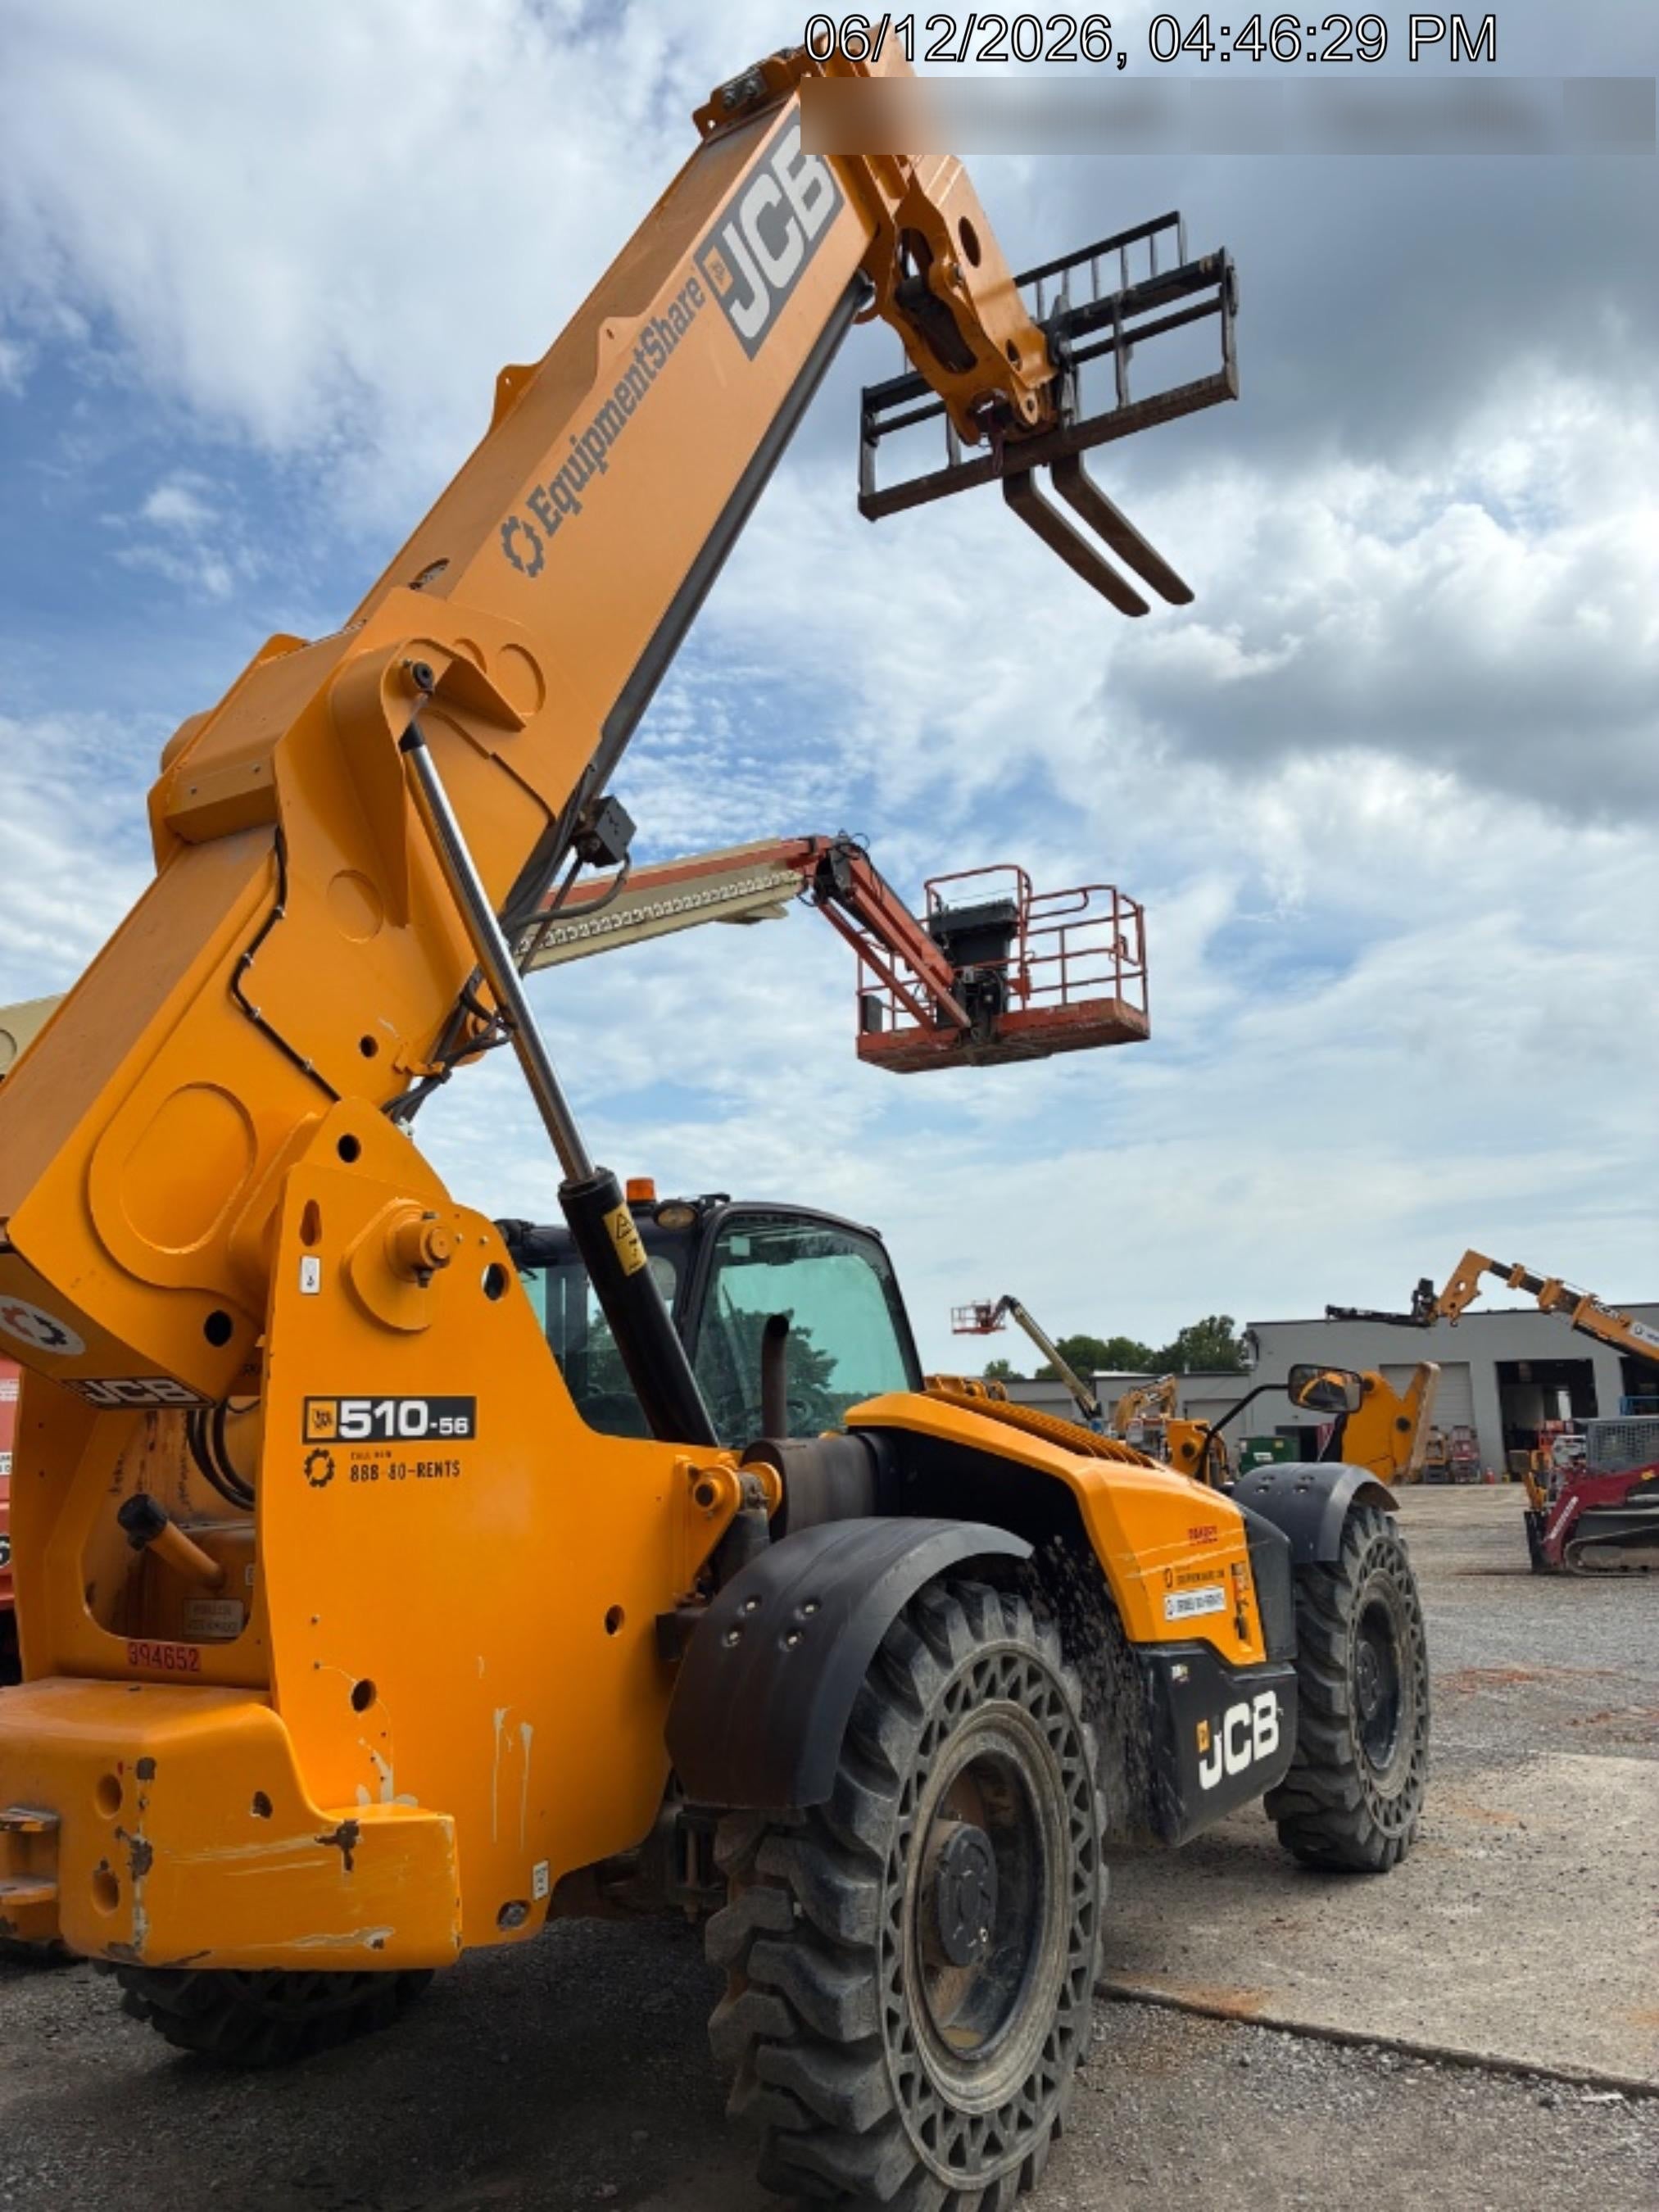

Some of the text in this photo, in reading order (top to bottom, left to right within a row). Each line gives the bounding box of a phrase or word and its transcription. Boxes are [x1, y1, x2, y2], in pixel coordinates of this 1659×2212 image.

[722, 125, 836, 338] JCB
[525, 275, 708, 538] EquipmentShare
[84, 1380, 200, 1404] JCB
[1199, 1689, 1280, 1790] JCB
